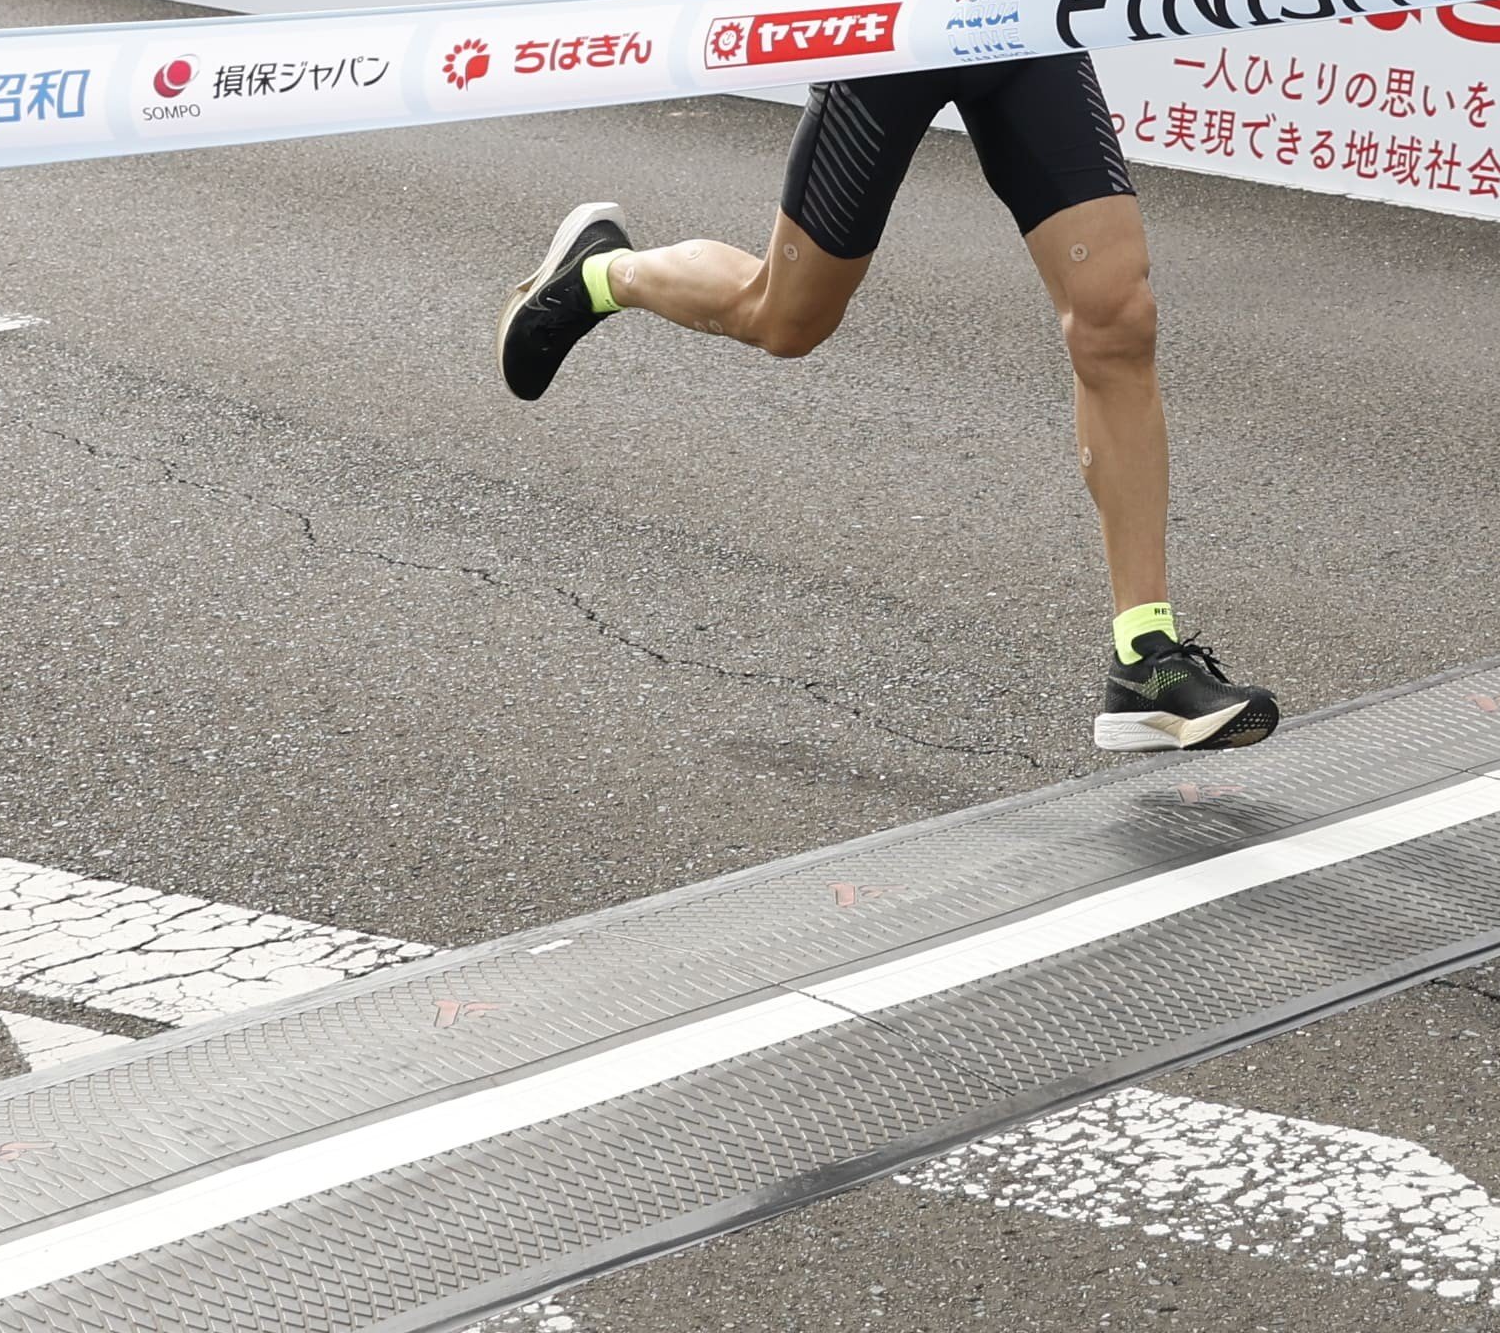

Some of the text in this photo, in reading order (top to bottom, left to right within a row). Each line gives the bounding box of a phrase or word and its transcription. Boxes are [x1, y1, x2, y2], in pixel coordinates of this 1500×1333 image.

[513, 31, 652, 74] ちばぎん
[758, 13, 888, 52] ヤマザキ
[212, 55, 389, 99] 損保ジャパン
[143, 104, 201, 121] SOMPO
